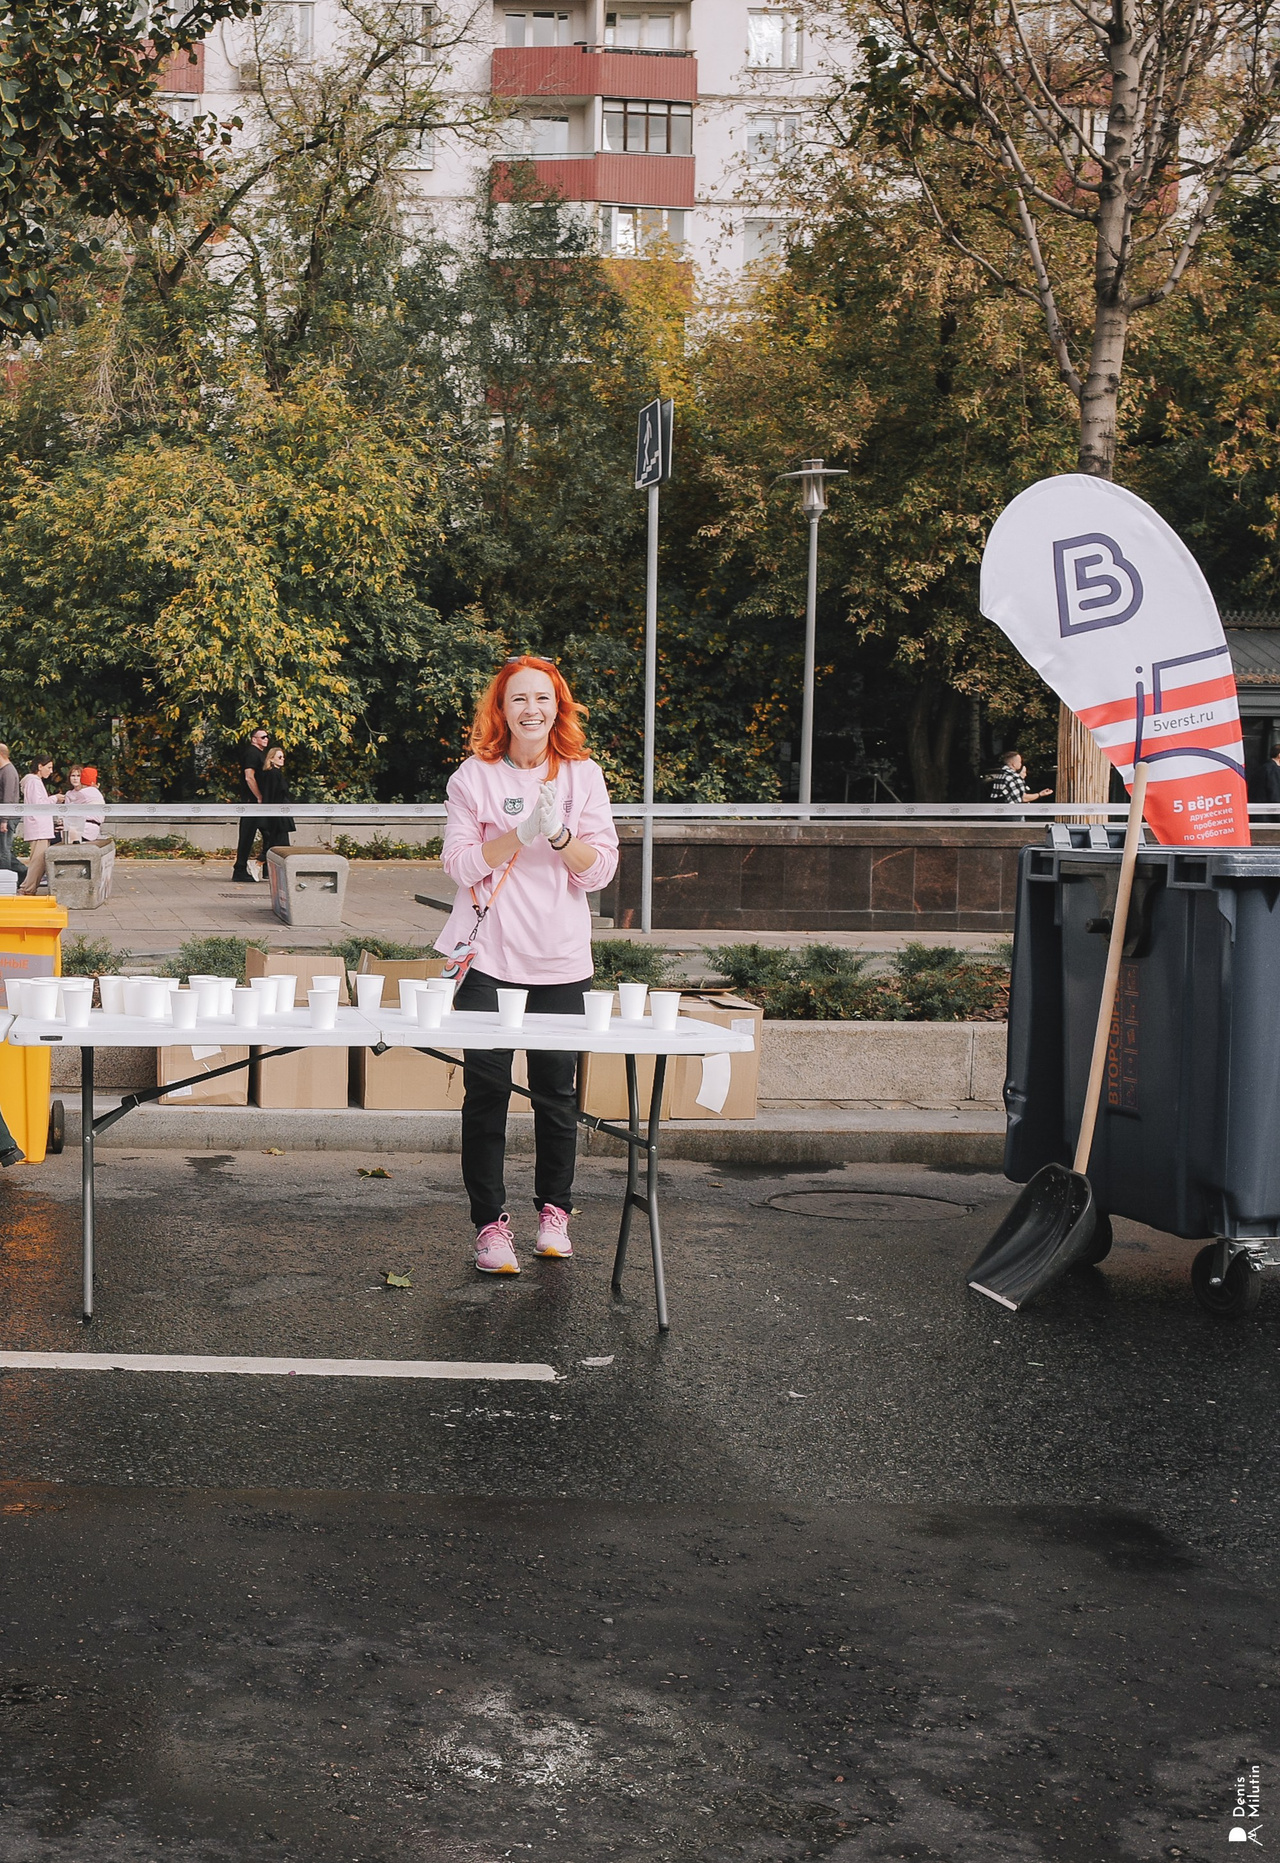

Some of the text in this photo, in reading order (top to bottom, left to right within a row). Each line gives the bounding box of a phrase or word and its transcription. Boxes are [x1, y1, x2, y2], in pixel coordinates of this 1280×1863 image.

[1153, 711, 1214, 732] 5verst.ru
[1173, 793, 1232, 813] 5 вёрст
[1189, 807, 1233, 822] дружеские
[1193, 817, 1234, 830] пробежки
[1196, 827, 1235, 840] субботам
